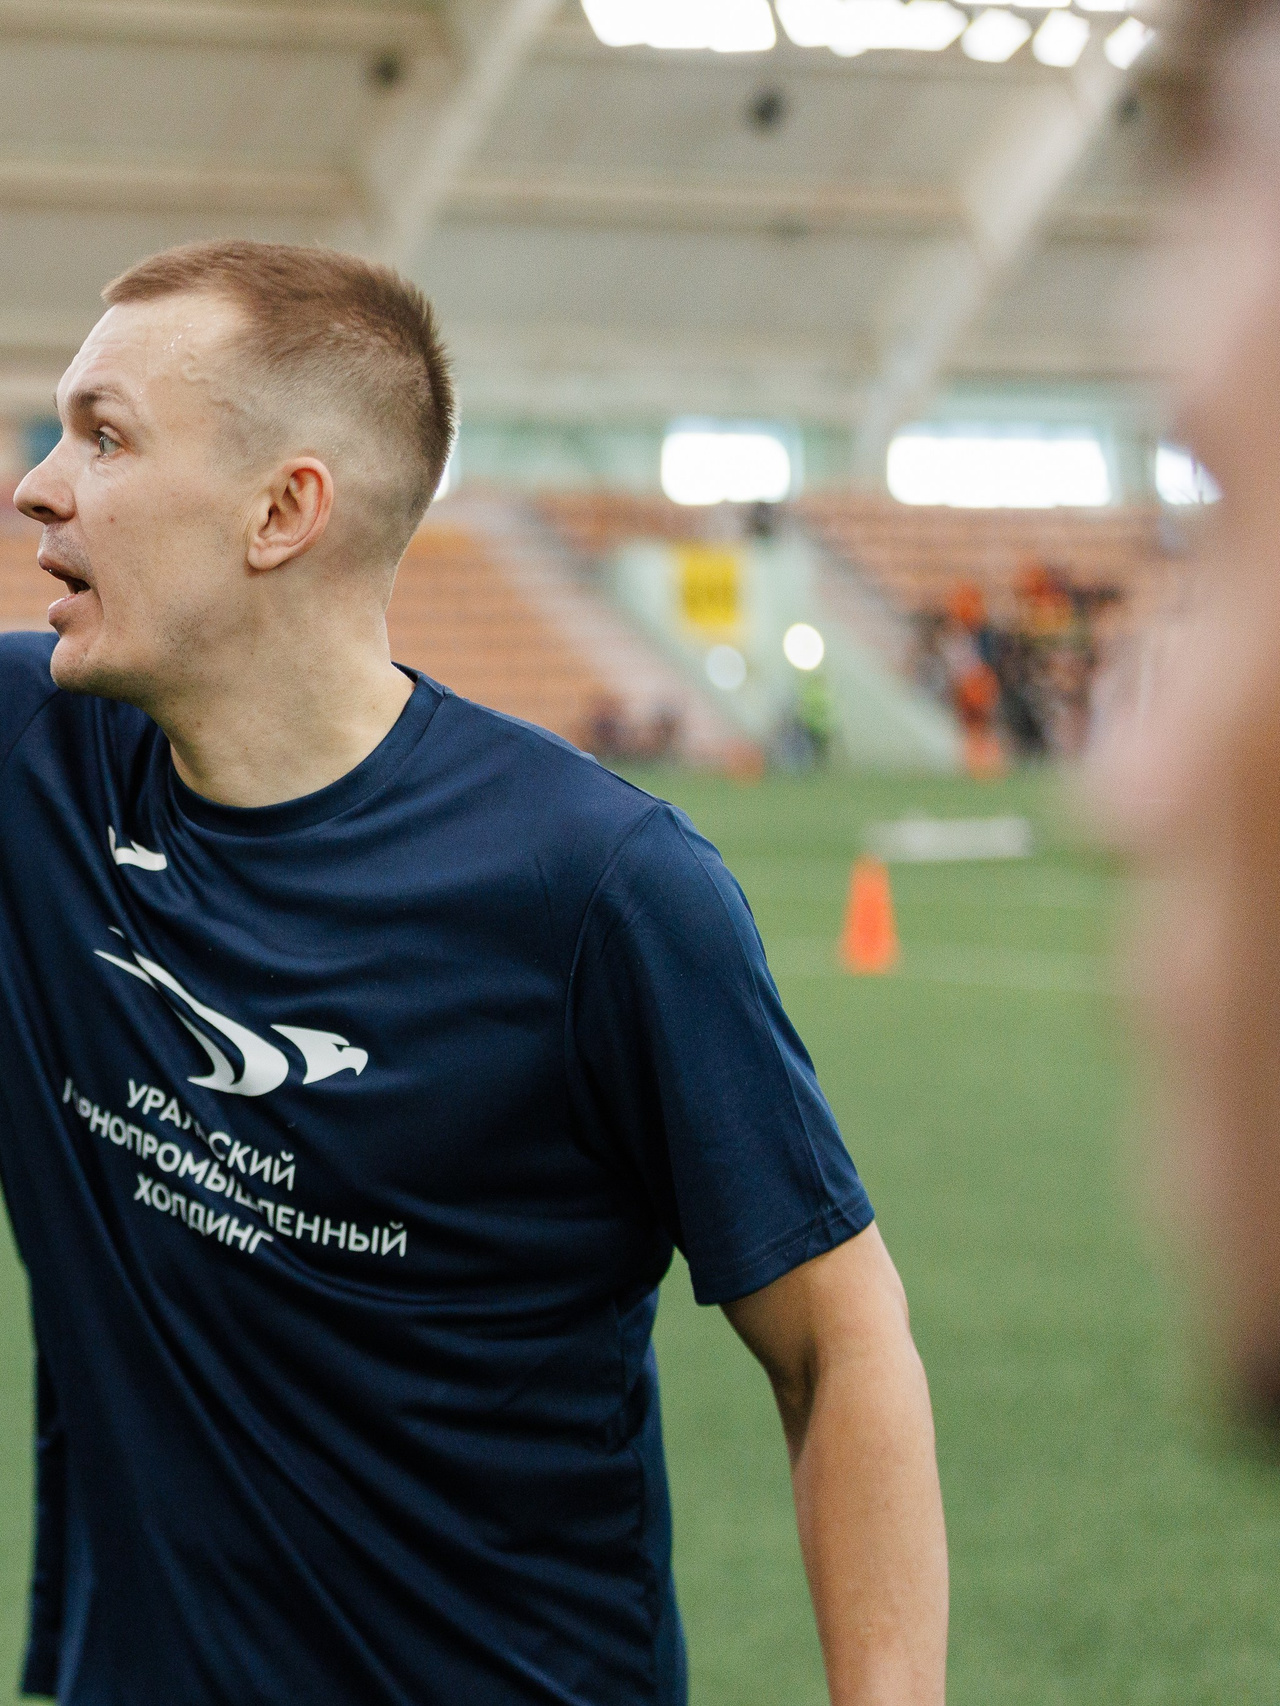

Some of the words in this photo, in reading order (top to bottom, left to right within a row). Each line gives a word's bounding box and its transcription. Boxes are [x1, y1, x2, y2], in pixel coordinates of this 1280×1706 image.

[62, 1077, 407, 1258] РНОПРОМЫЛЕННЫЙ
[126, 1078, 296, 1191] УРАСКИЙ
[133, 1172, 274, 1254] ХОЛДИНГ
